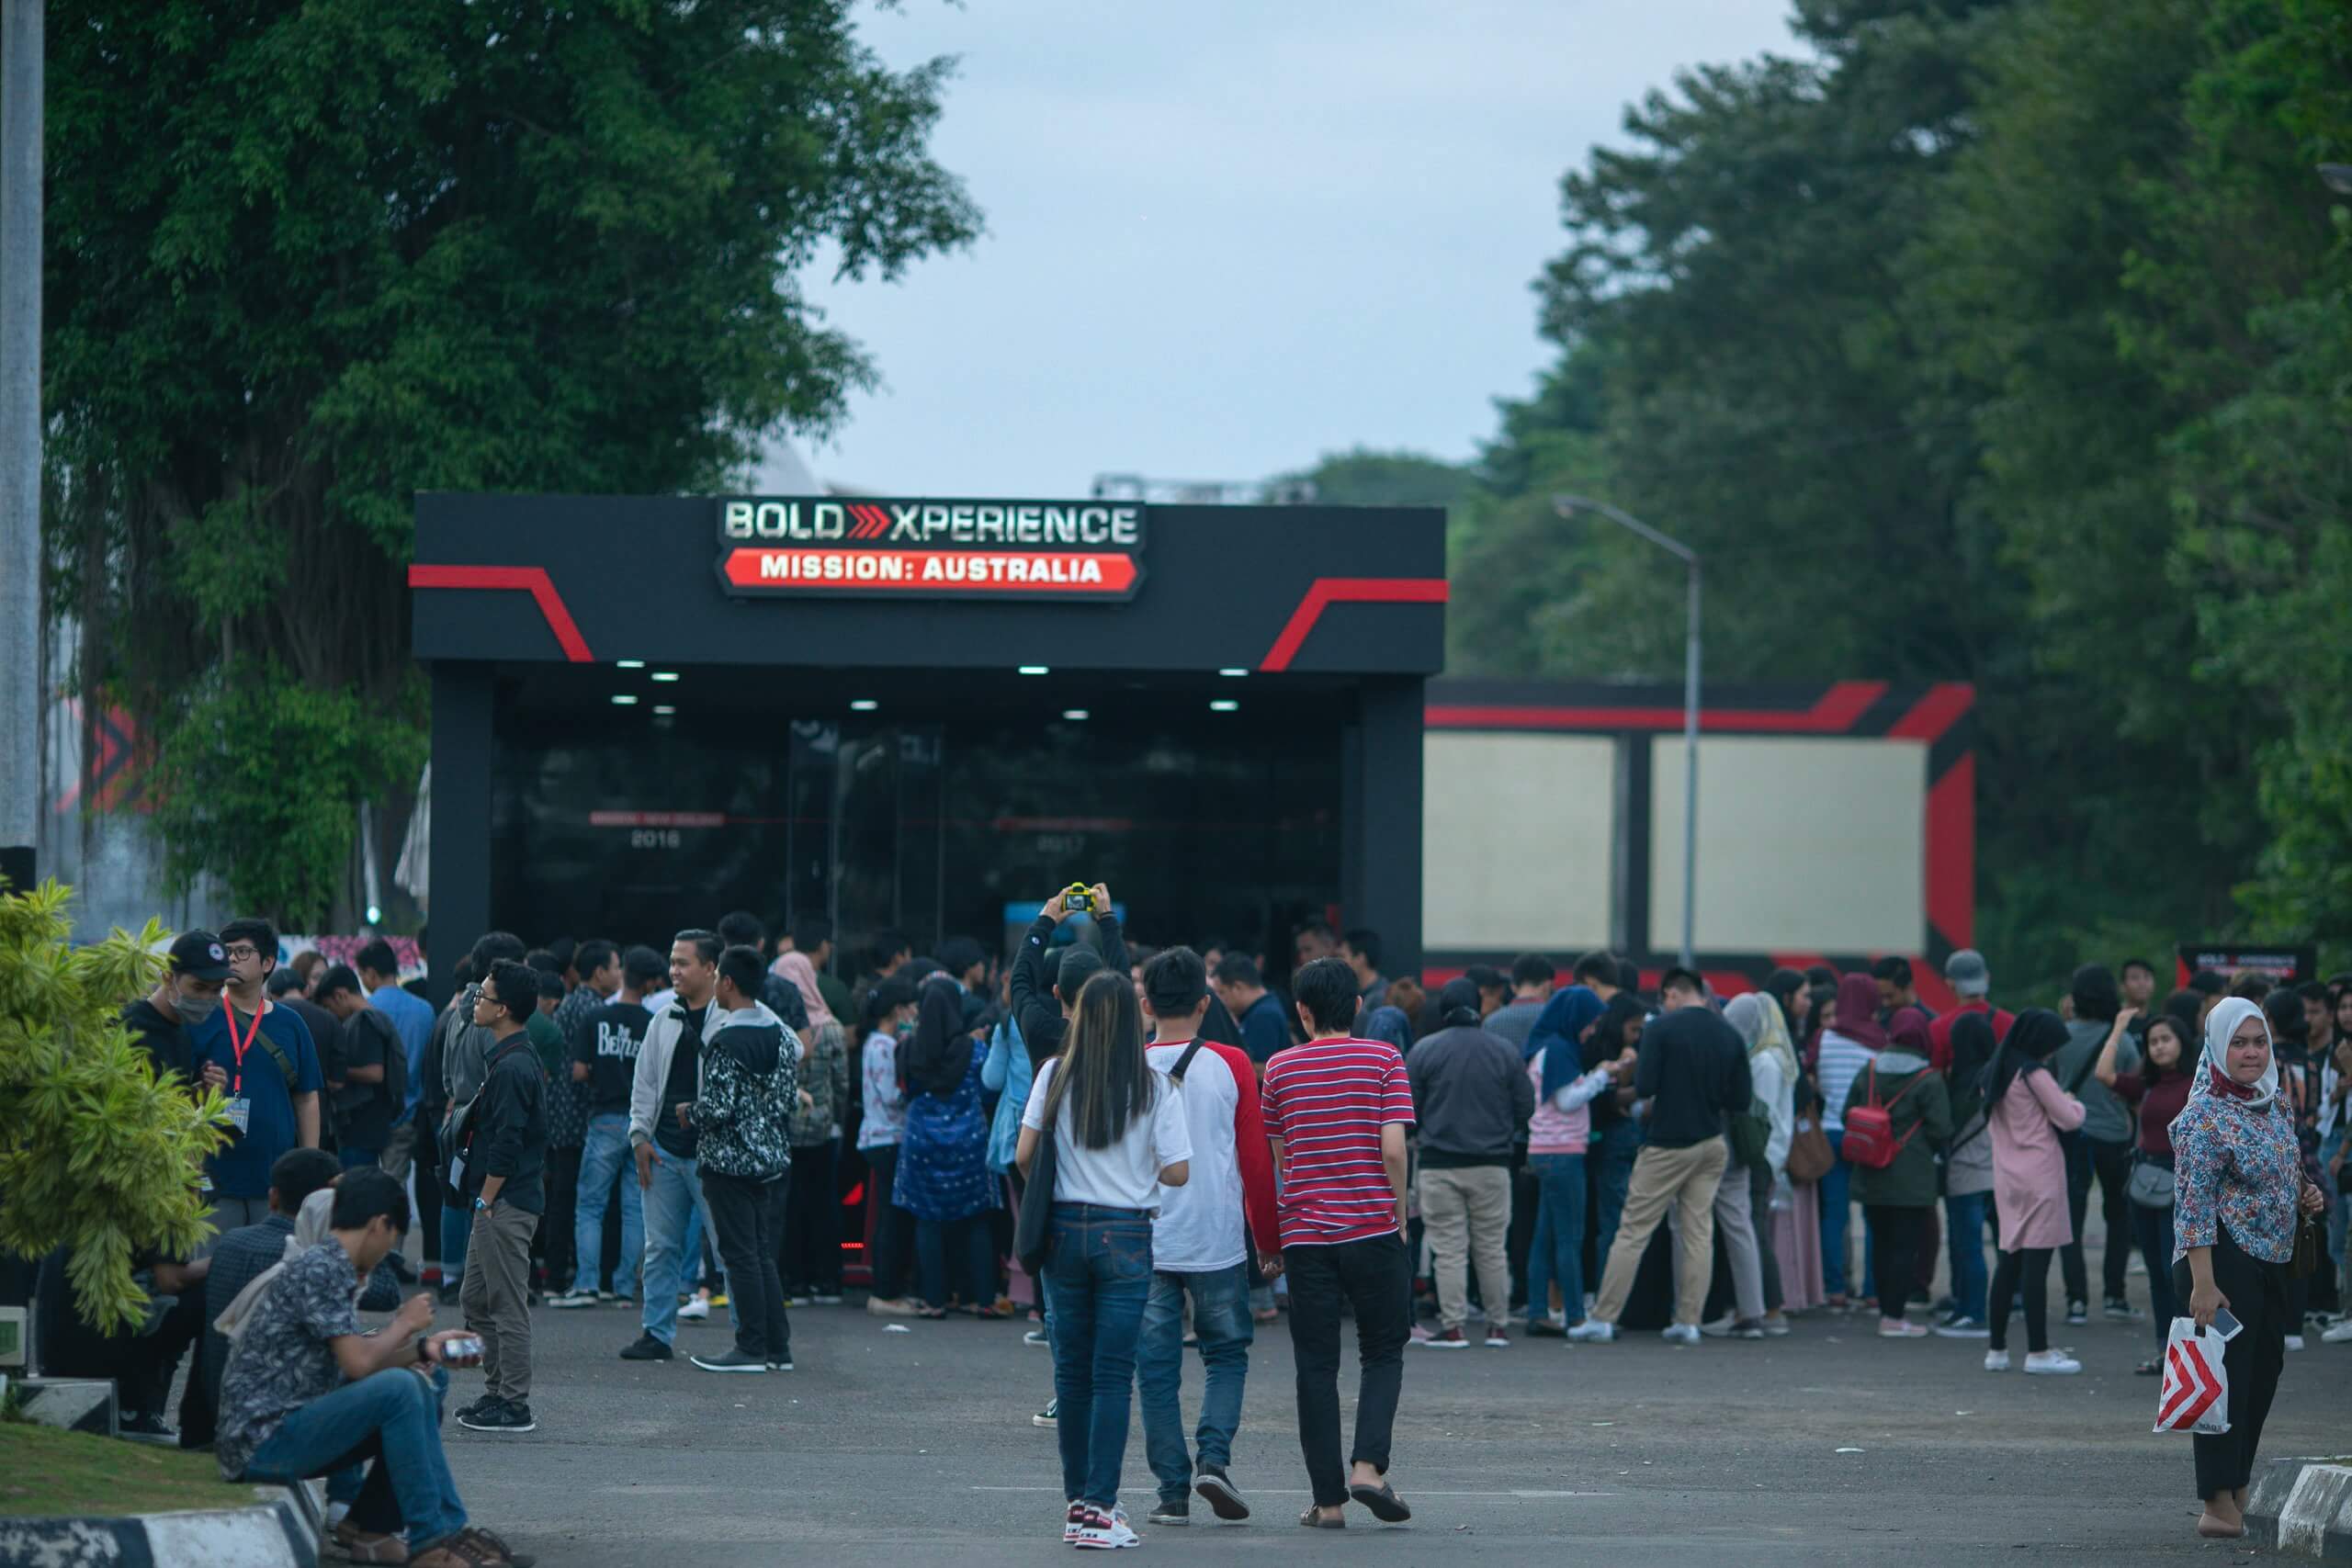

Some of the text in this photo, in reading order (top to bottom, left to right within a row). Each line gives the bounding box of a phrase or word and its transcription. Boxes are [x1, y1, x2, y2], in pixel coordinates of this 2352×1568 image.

[725, 502, 1138, 544] BOLD XPERIENCE
[760, 554, 1102, 583] MISSION: AUSTRALIA
